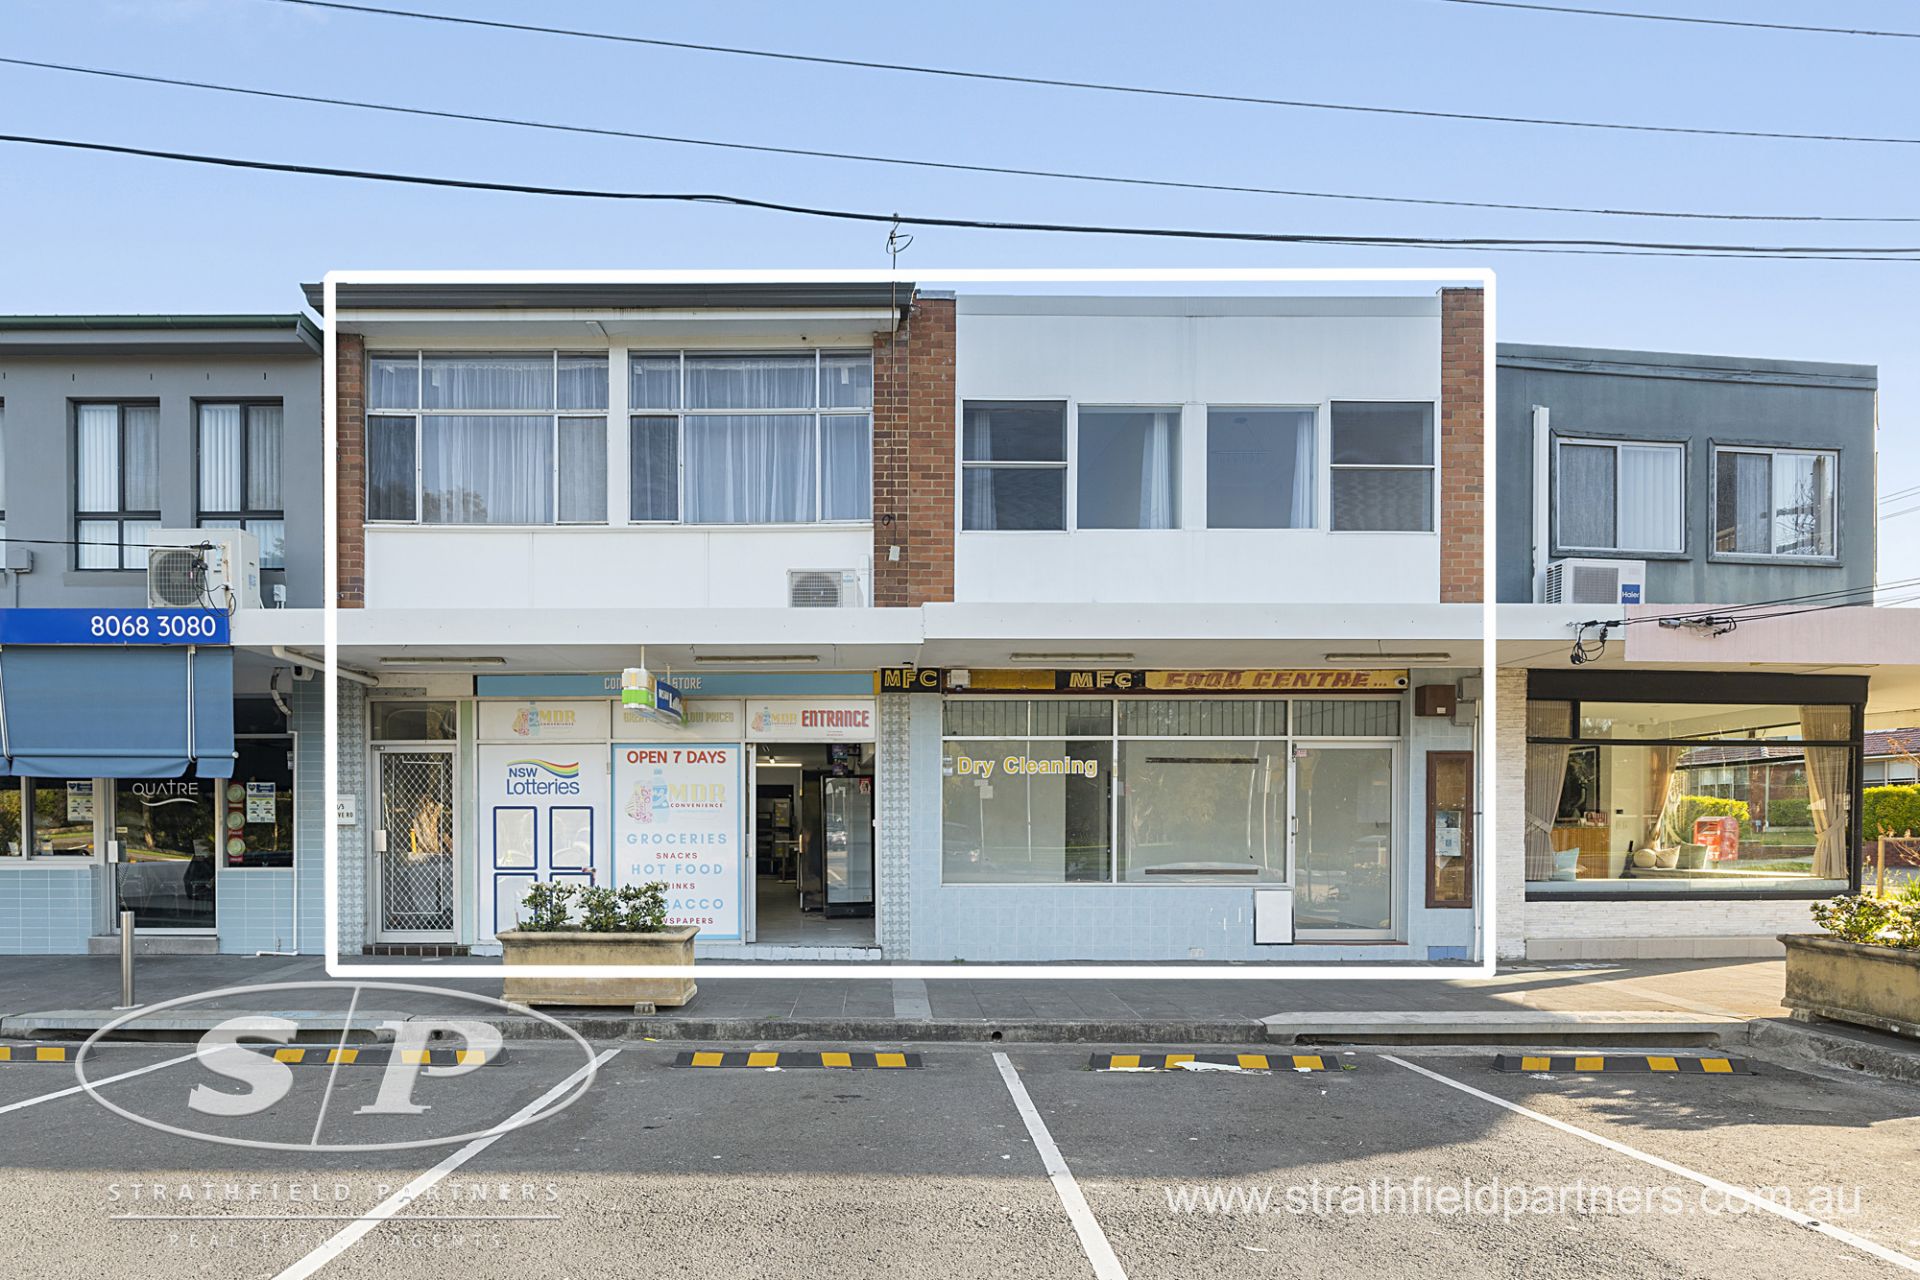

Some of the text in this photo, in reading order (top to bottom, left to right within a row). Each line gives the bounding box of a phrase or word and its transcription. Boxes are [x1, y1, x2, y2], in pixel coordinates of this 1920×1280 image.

[91, 615, 216, 637] 8068 3080
[672, 677, 702, 690] STORE
[884, 668, 938, 689] MFC
[1069, 670, 1133, 689] MFC
[801, 710, 870, 728] ENTRANCE
[627, 750, 727, 764] OPEN 7 DAYS
[509, 767, 538, 777] NSW
[957, 756, 1098, 778] Dry Cleaning
[132, 779, 199, 798] QUATRE
[506, 778, 580, 795] Lotteries
[668, 783, 727, 802] MDR
[626, 833, 728, 845] GROCERIES
[655, 852, 699, 860] SNACKS
[631, 863, 723, 875] HOT FOOD
